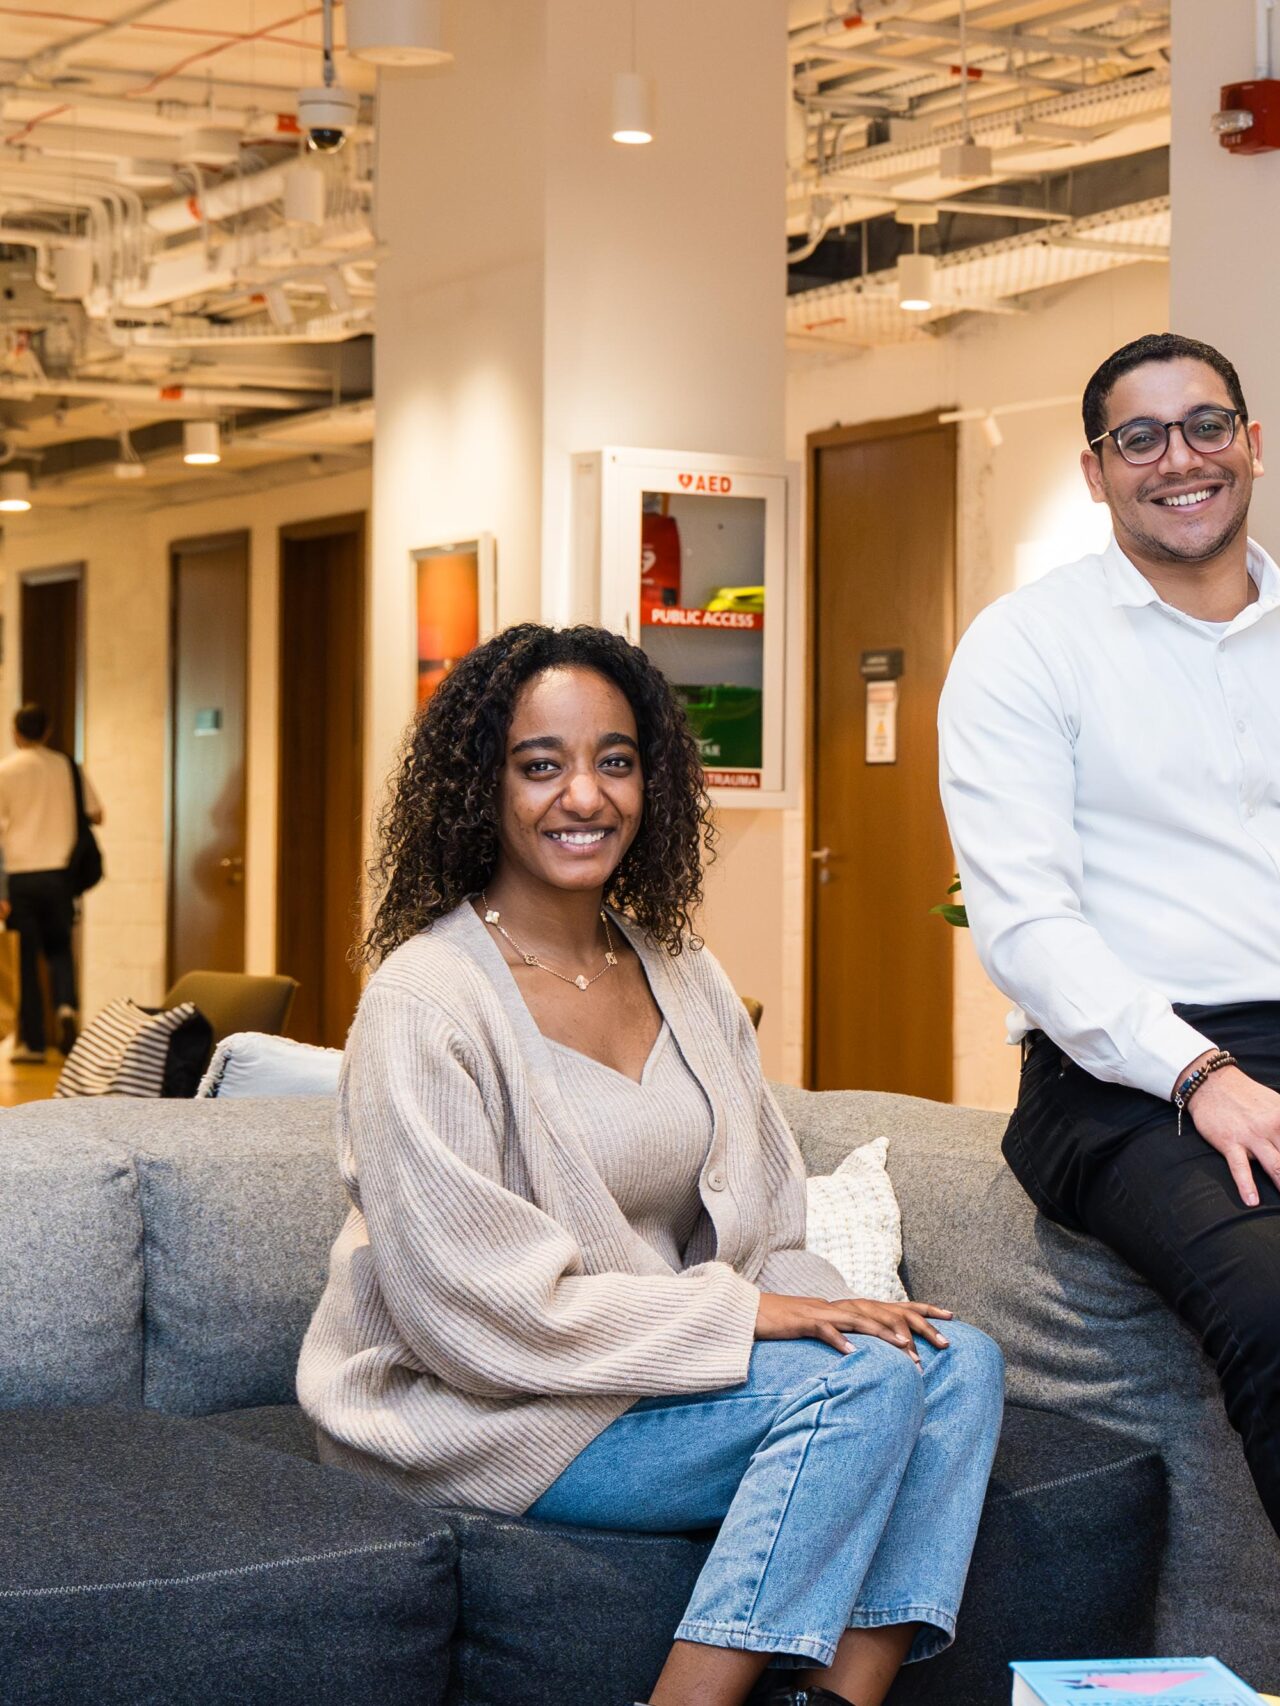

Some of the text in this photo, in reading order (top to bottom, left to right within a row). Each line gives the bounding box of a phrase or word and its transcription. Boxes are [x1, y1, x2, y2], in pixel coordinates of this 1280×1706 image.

[695, 475, 732, 493] AED
[651, 610, 755, 628] PUBLIC ACCESS
[708, 773, 759, 786] TRAUMA
